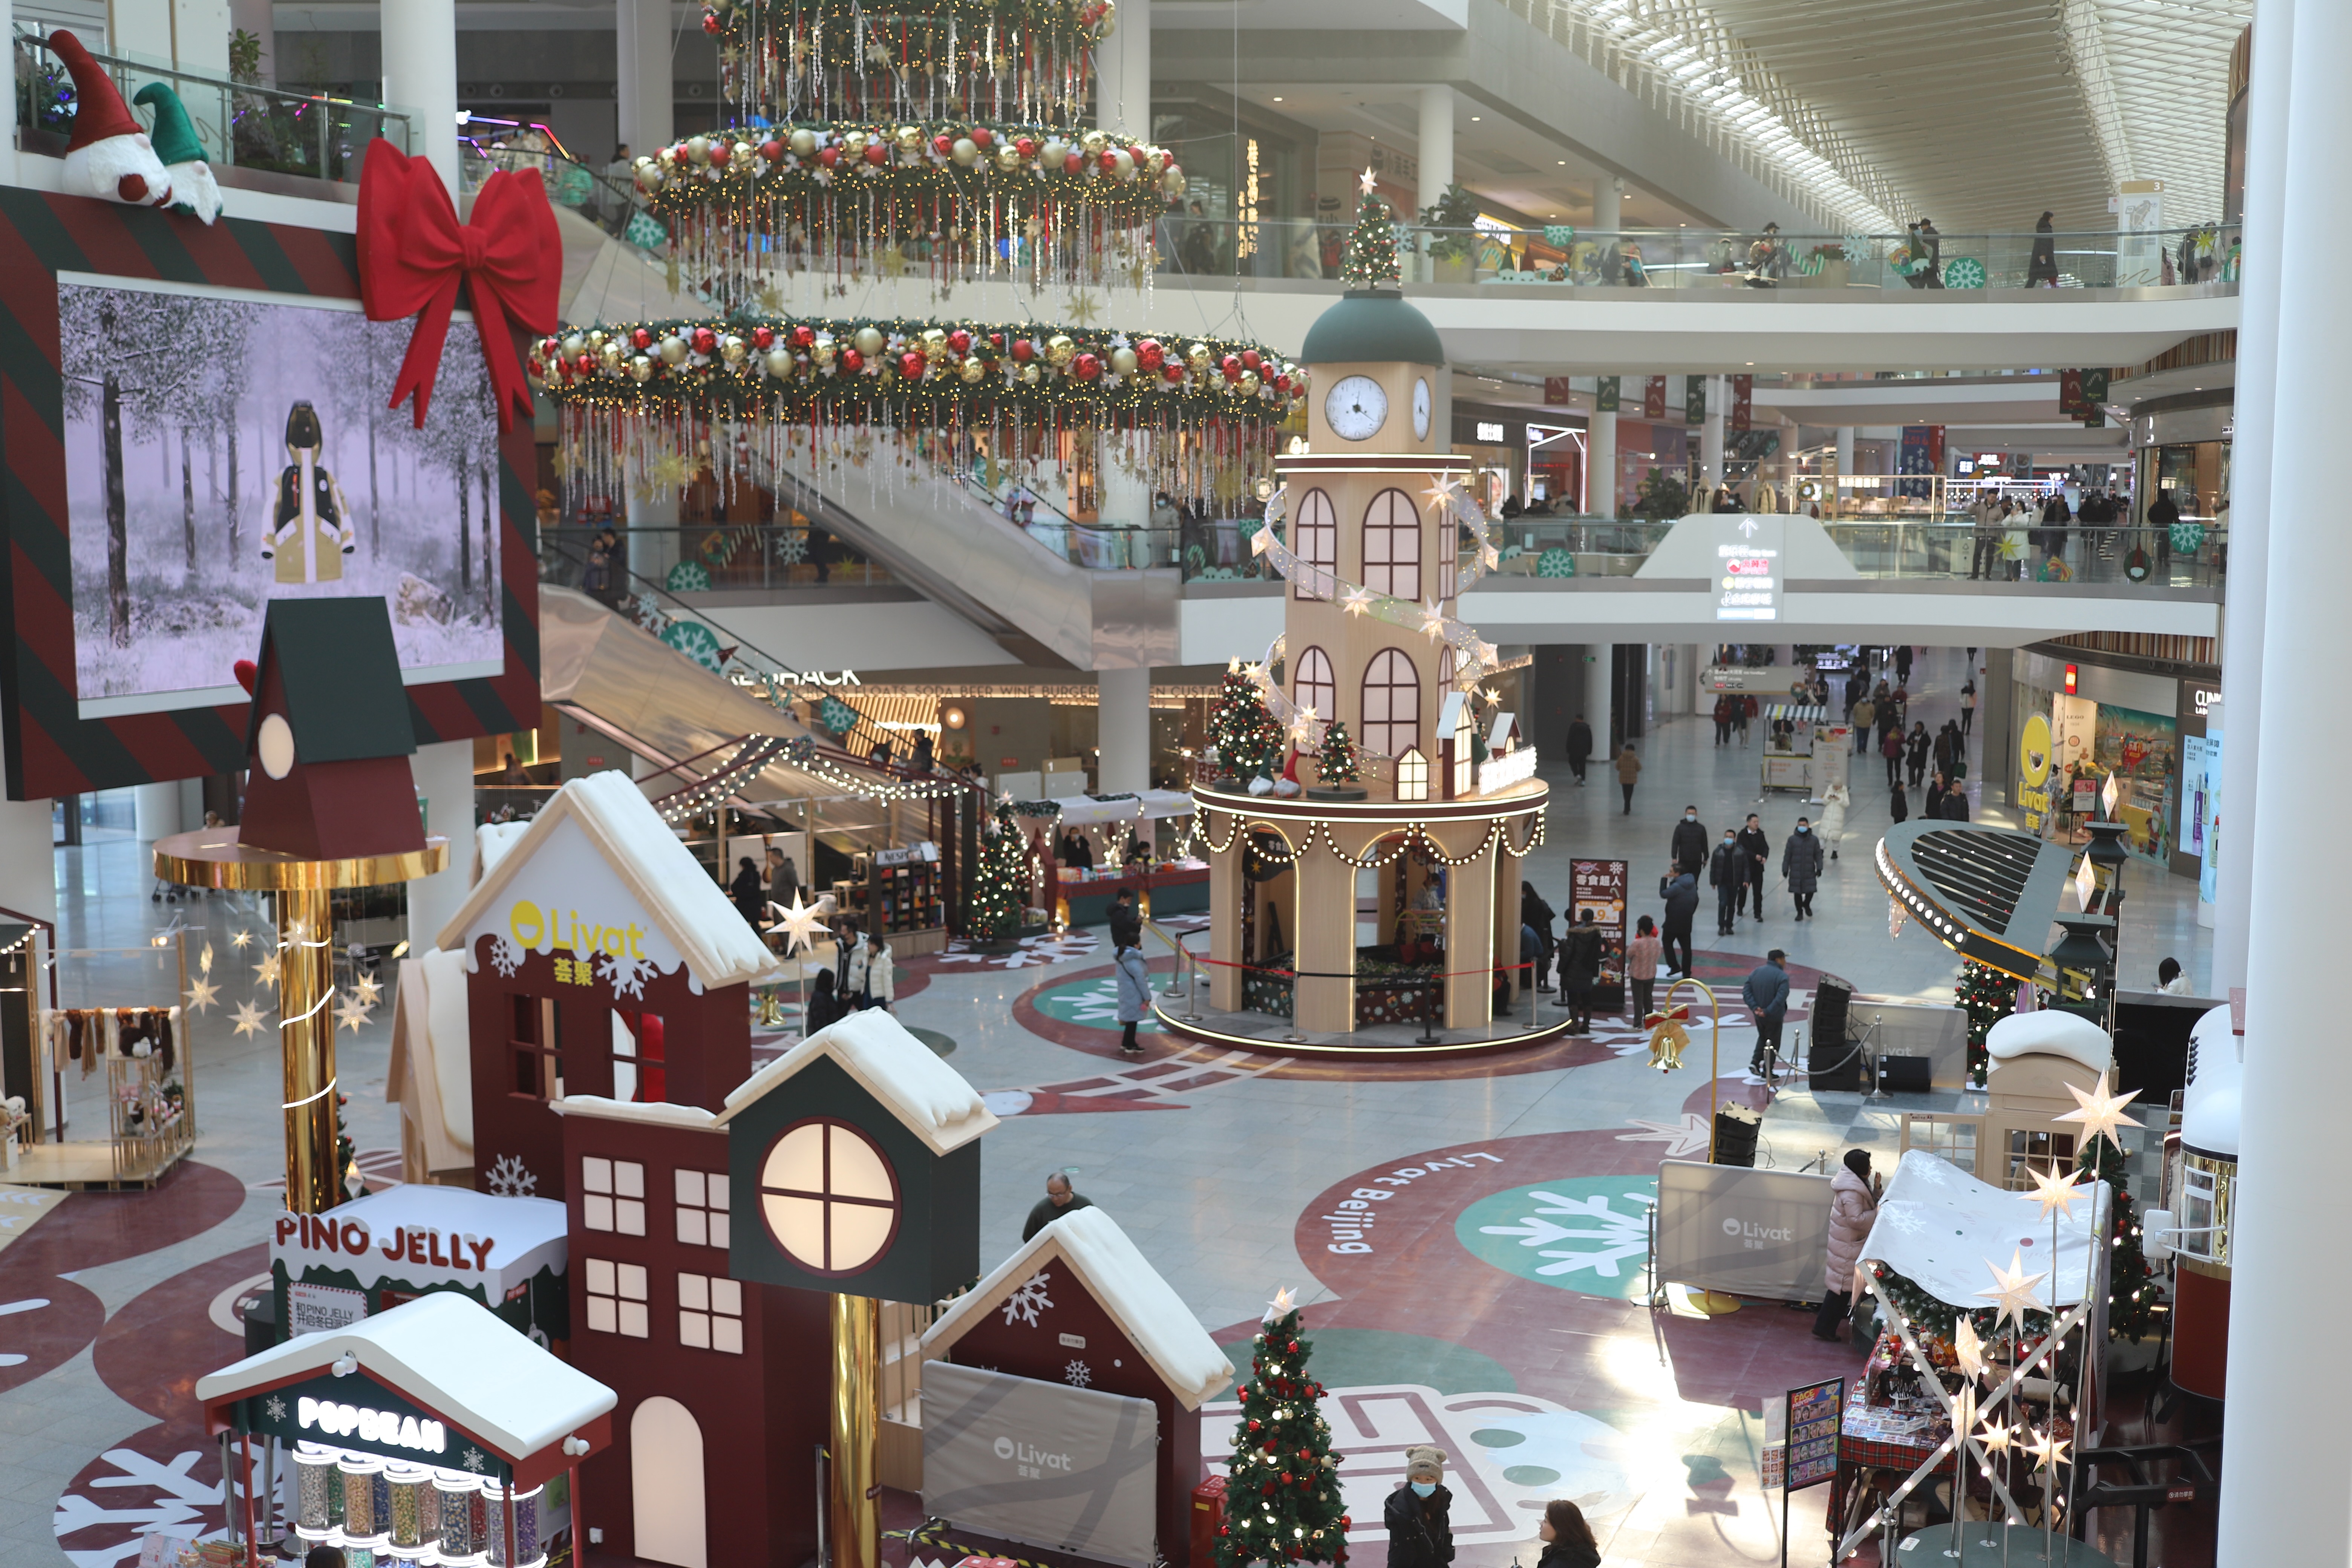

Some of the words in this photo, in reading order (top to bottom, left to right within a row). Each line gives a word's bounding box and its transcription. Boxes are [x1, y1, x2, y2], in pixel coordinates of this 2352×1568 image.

[2154, 182, 2160, 190] 3
[916, 685, 953, 696] SODA
[960, 686, 993, 696] BEER
[1000, 686, 1036, 695] WINE
[1042, 686, 1097, 696] BURGER
[1048, 761, 1054, 772] 1
[2018, 781, 2049, 813] Livat
[1576, 874, 1622, 887] 零食超人
[551, 908, 646, 960] Livat
[553, 957, 594, 987] 荟聚
[1879, 1044, 1912, 1057] ivat
[1373, 1152, 1505, 1186] Livat
[1321, 1187, 1395, 1255] Beijing
[1744, 1221, 1791, 1242] Livat
[275, 1212, 371, 1256] PINO
[380, 1225, 494, 1272] JELLY
[330, 1307, 354, 1321] JELLY
[1792, 1396, 1815, 1409] PAINTING
[1794, 1388, 1815, 1403] FACE
[298, 1396, 447, 1454] POPBEAN
[1018, 1442, 1072, 1471] Livat
